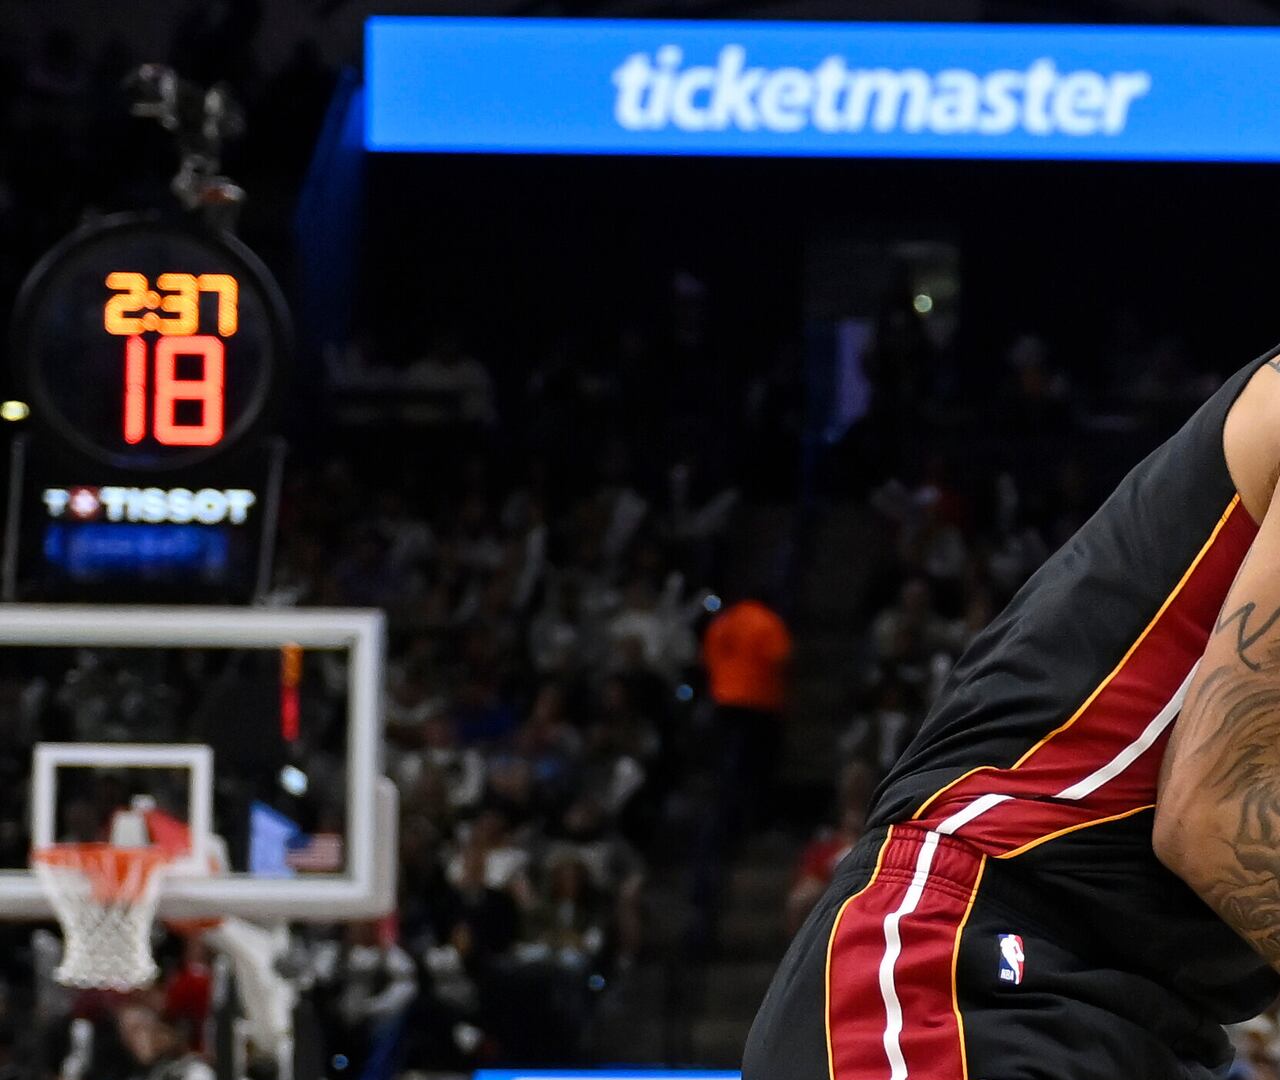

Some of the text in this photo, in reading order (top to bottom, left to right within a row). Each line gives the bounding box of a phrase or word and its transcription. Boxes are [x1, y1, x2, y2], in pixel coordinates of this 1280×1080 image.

[612, 44, 1151, 136] ticketmaster
[105, 271, 239, 337] 2:37
[124, 335, 225, 446] 18
[101, 486, 256, 525] TISSOT
